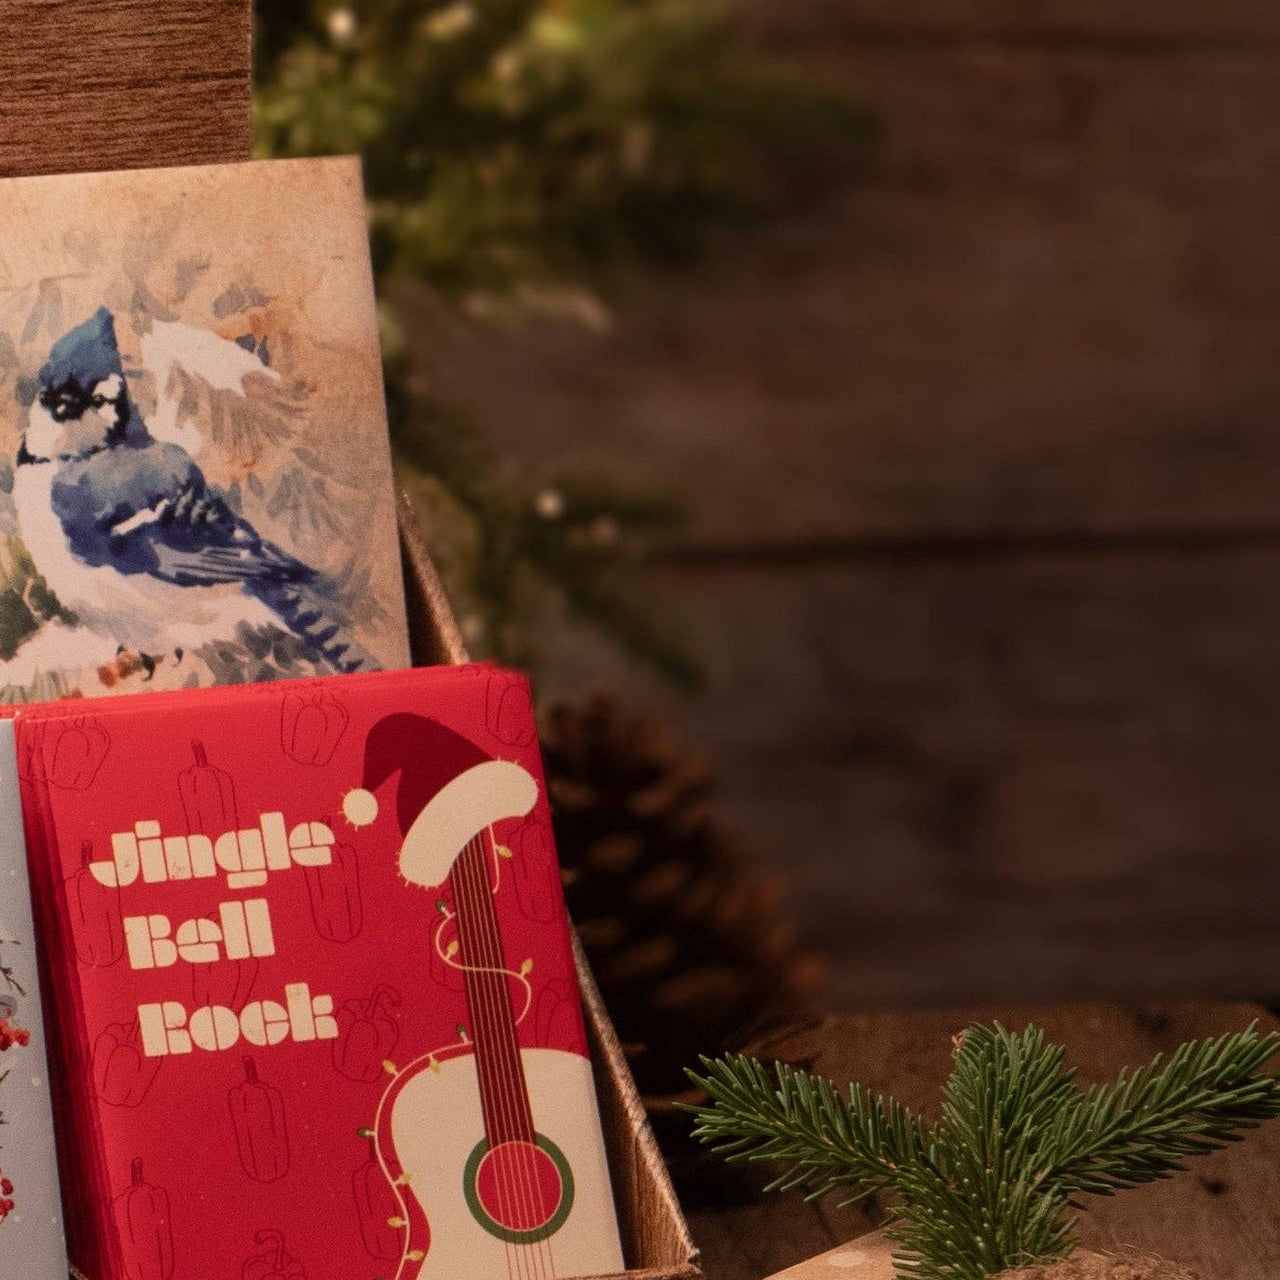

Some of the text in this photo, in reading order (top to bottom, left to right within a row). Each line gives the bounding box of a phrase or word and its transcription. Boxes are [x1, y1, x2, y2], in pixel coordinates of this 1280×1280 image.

[89, 812, 336, 889] Jingle
[123, 898, 276, 970] Bell
[137, 982, 339, 1057] Rock
